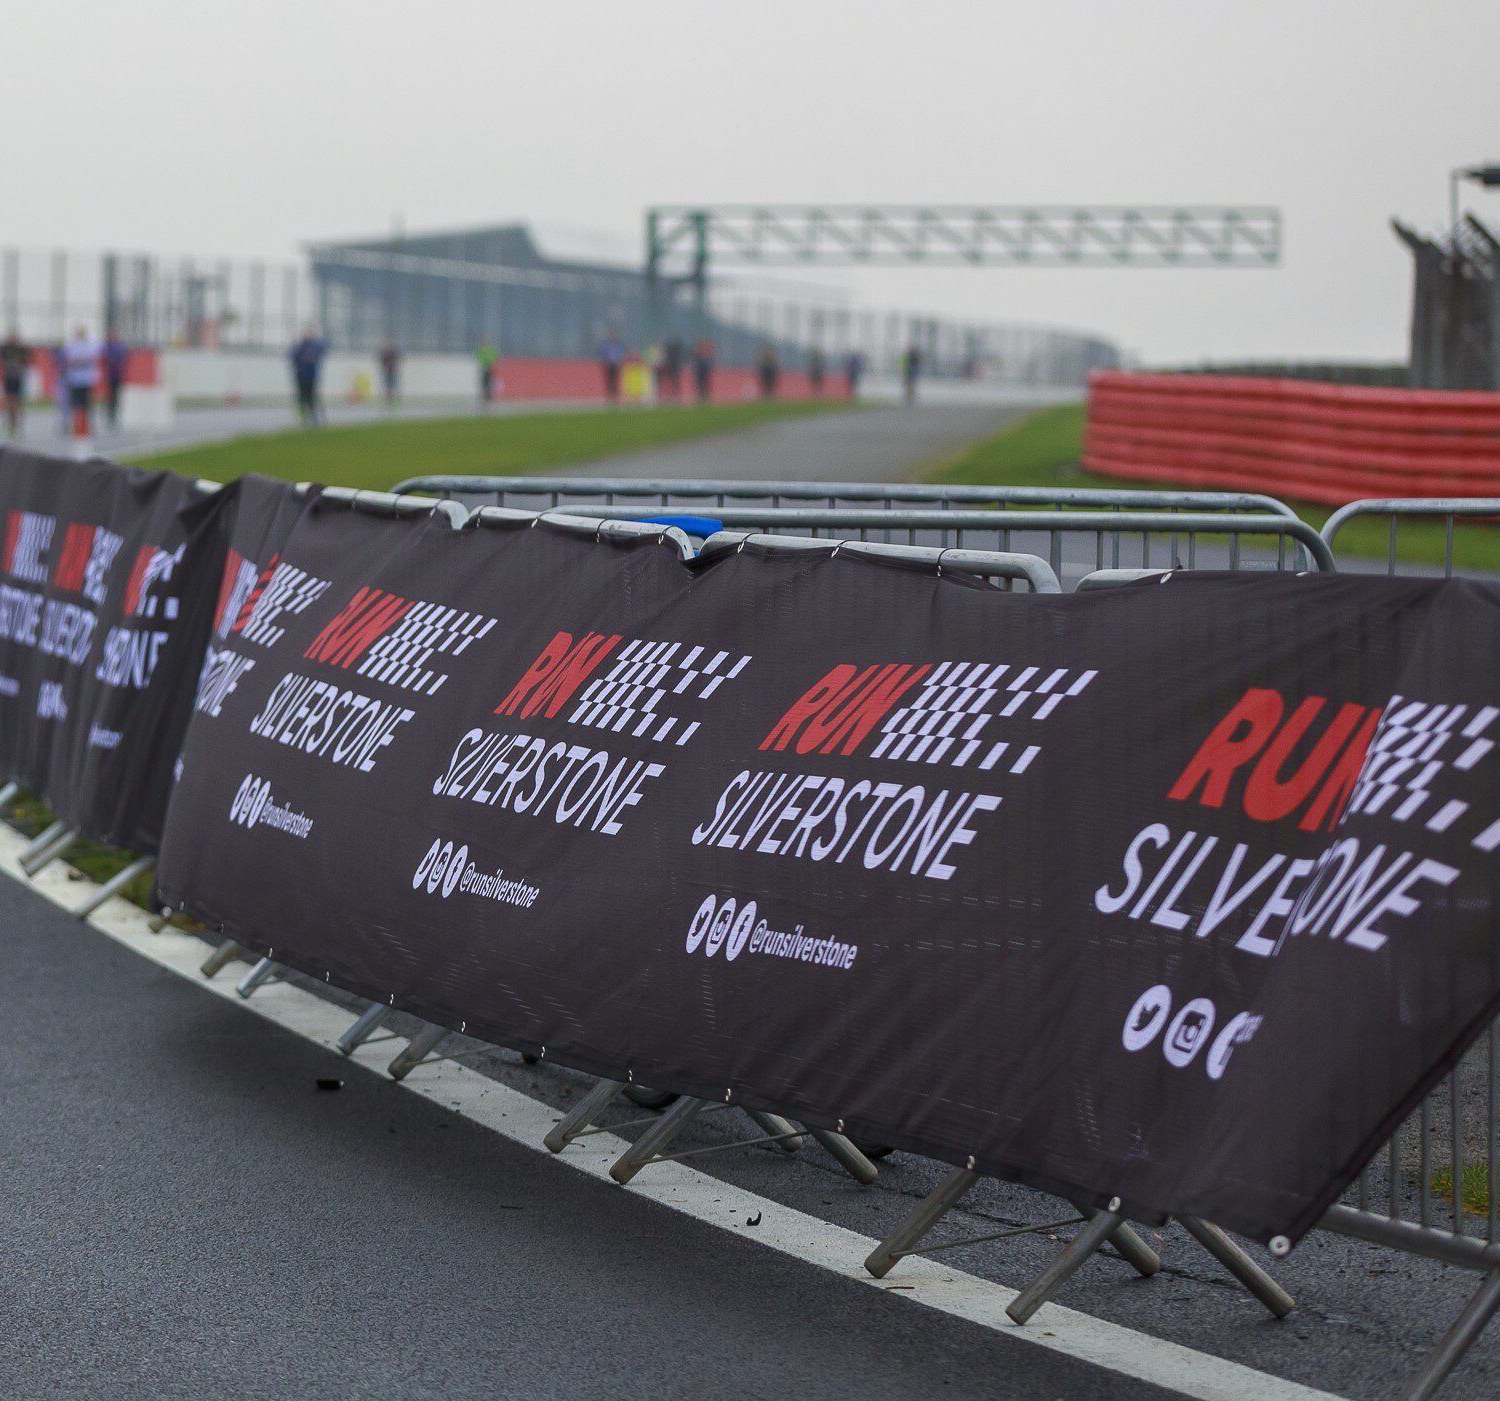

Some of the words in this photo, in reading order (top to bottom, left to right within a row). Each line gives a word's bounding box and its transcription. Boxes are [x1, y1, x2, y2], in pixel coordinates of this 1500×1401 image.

[249, 672, 416, 773] SILVERSTONE
[758, 663, 934, 756] RUN
[1167, 687, 1383, 832] RUN
[432, 728, 667, 836] SILVERSTONE
[691, 769, 1003, 880] SILVERSTONE
[459, 861, 540, 909] @runsilverstone
[749, 918, 858, 970] @runsilverstone
